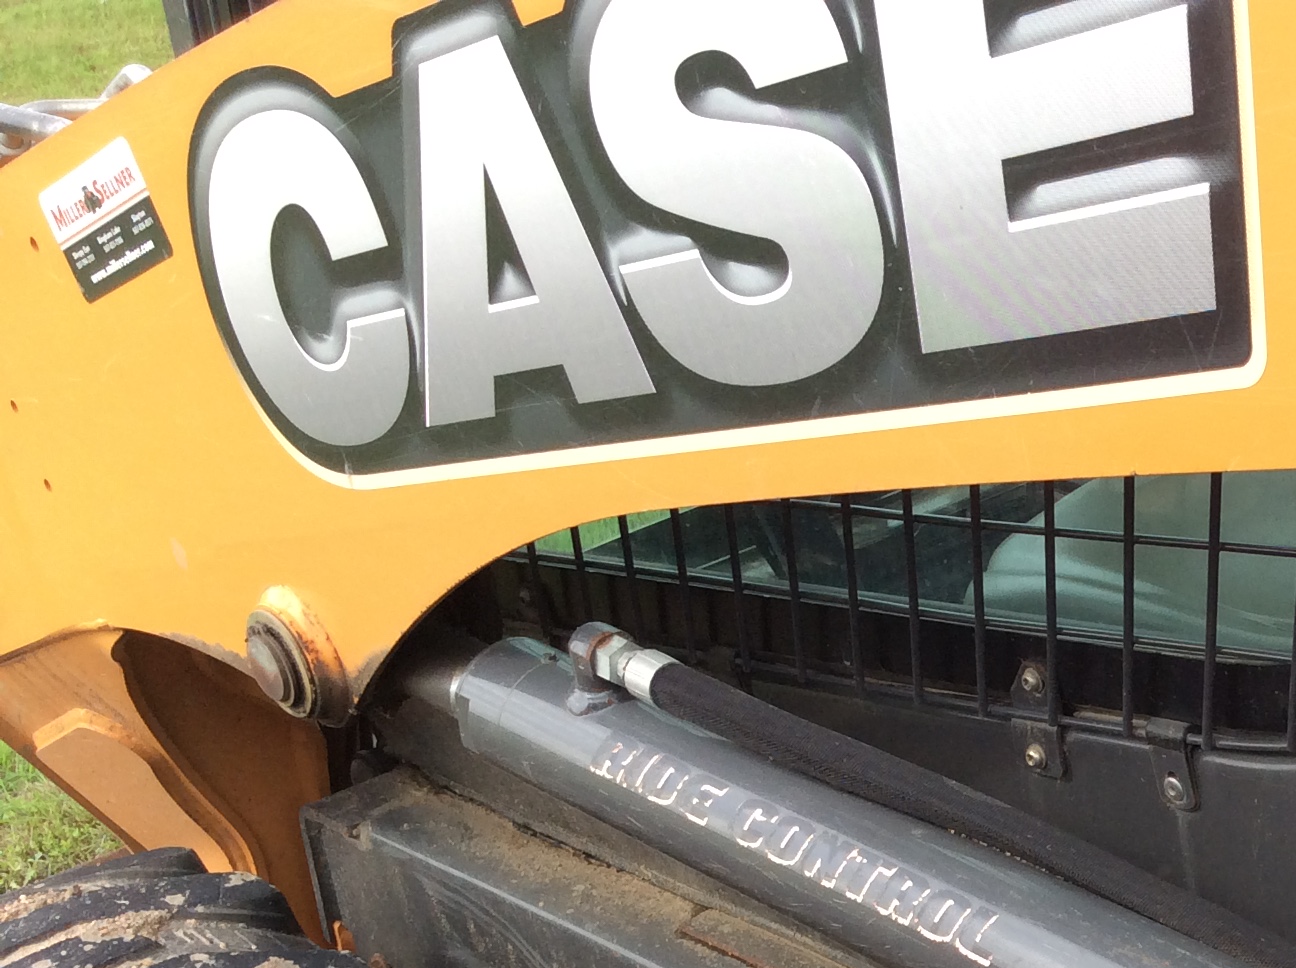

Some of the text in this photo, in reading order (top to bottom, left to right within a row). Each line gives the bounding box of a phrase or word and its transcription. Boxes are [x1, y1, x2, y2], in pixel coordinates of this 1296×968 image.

[50, 199, 90, 232] MILLER
[92, 166, 136, 205] SELLNER
[207, 0, 1217, 447] CASE
[732, 799, 1000, 967] CONTROL
